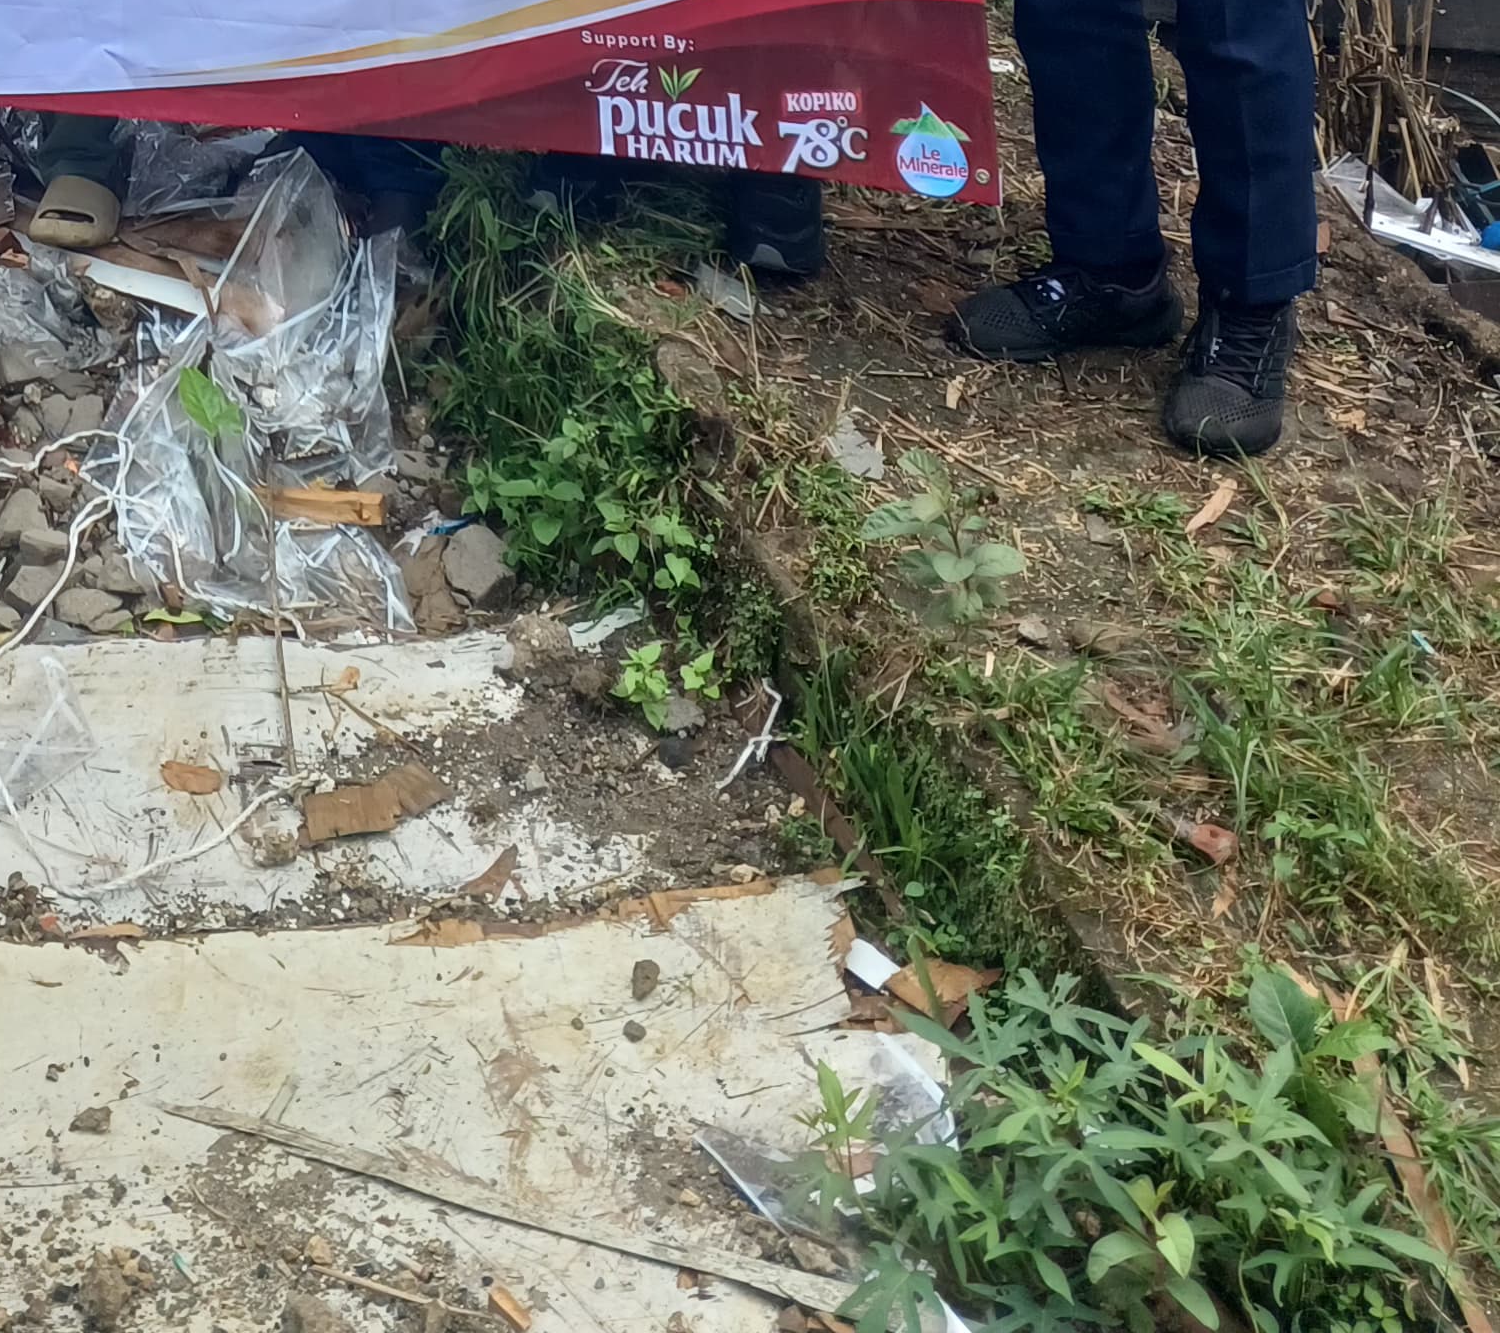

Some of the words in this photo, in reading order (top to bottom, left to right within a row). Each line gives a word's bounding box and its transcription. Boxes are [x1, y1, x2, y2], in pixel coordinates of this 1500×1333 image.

[581, 30, 658, 49] Support
[663, 34, 695, 54] By:
[584, 58, 650, 94] Teh
[785, 92, 858, 113] KOPIKO
[596, 92, 765, 157] pucuk
[626, 134, 750, 169] HARUM
[921, 143, 941, 161] Le
